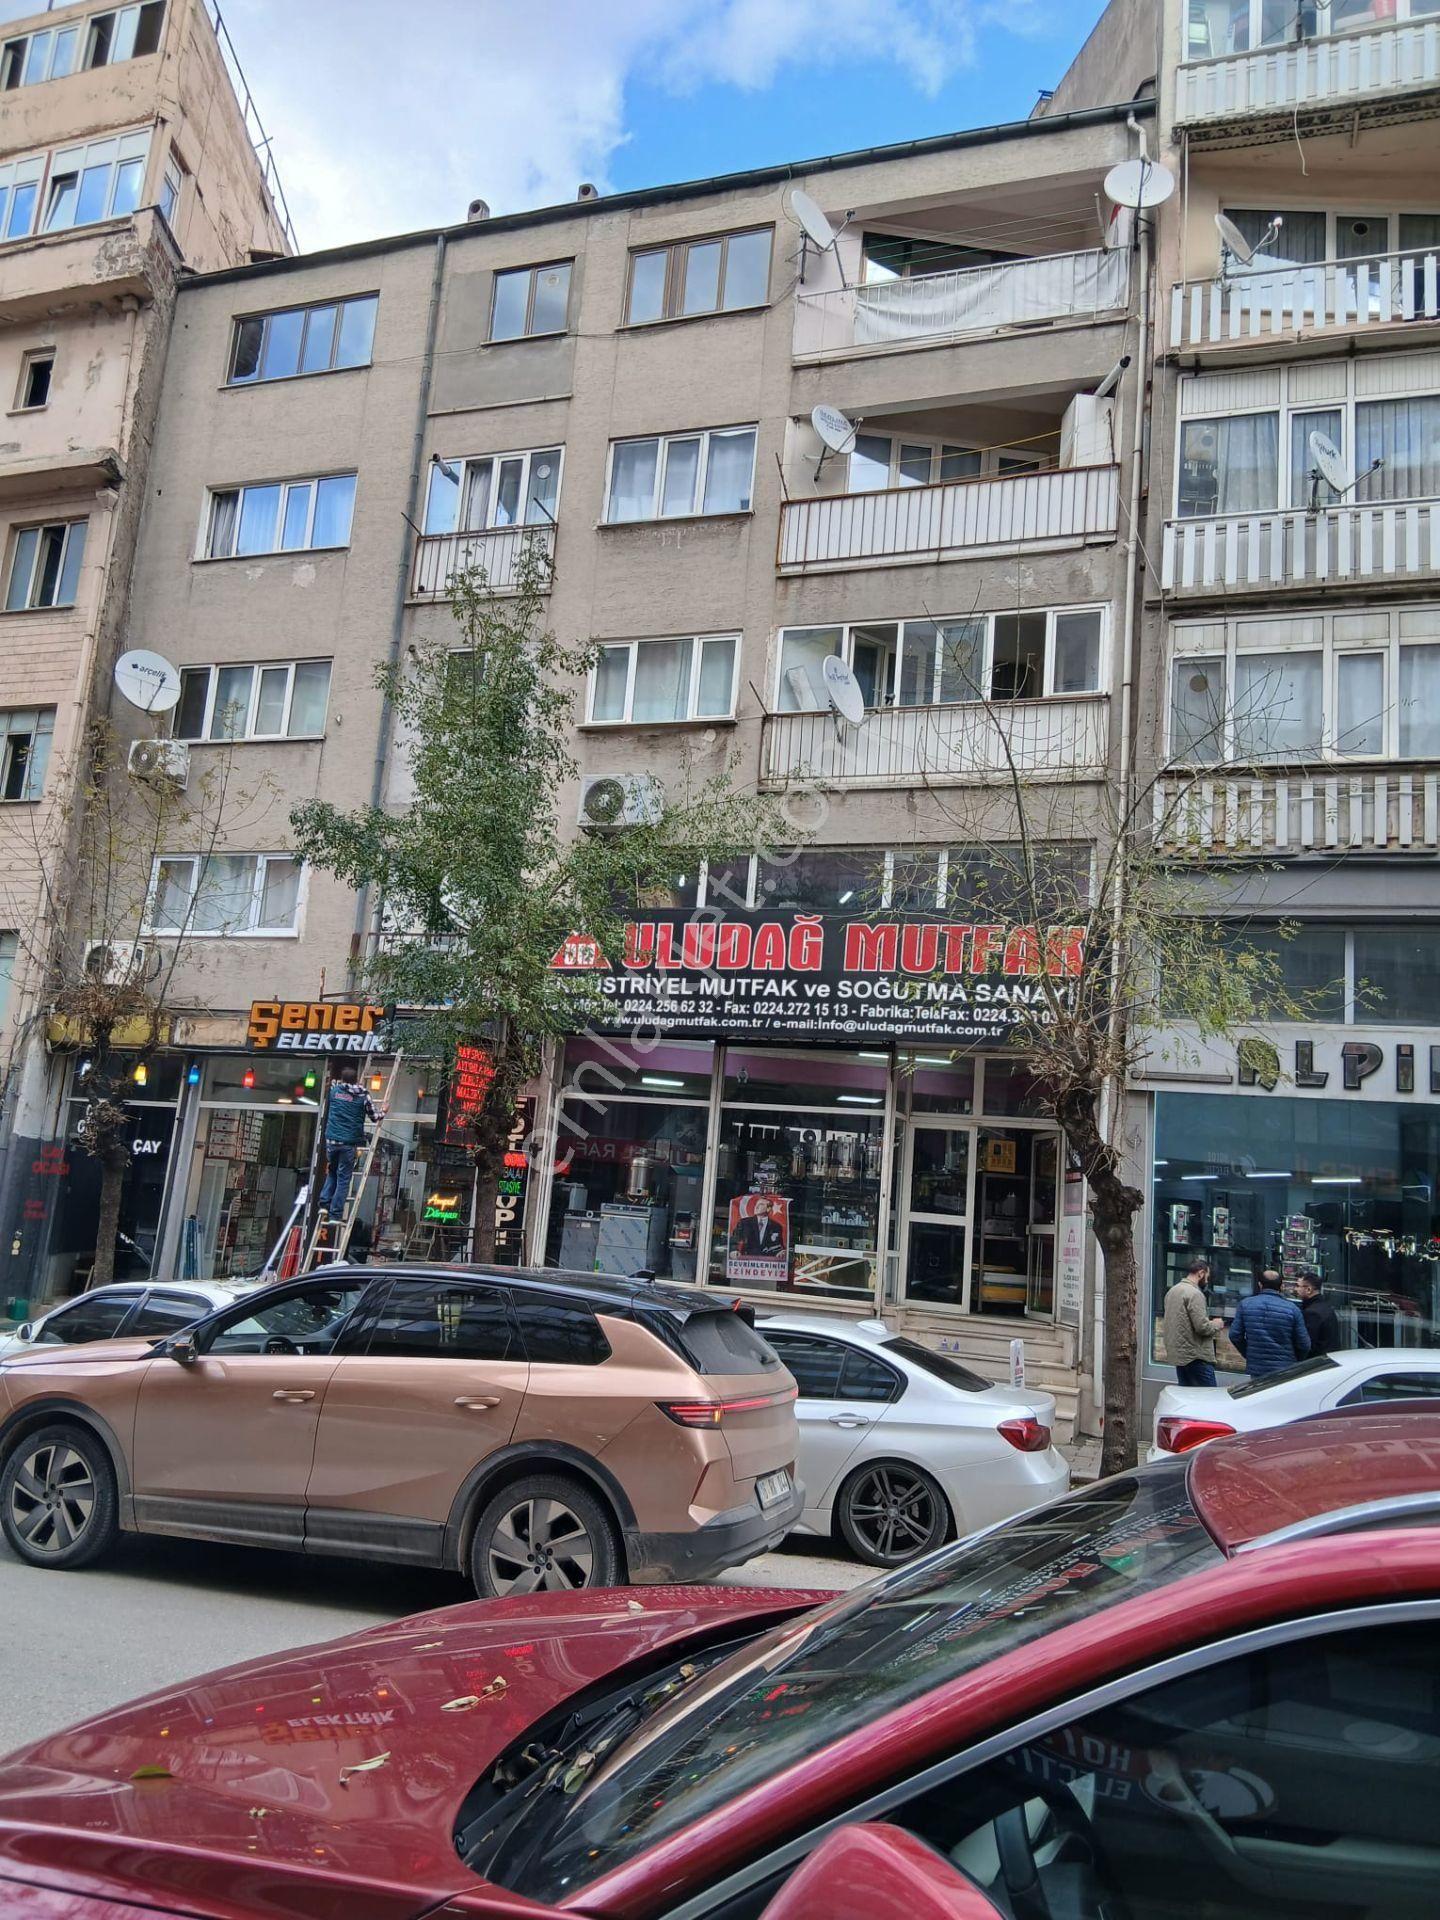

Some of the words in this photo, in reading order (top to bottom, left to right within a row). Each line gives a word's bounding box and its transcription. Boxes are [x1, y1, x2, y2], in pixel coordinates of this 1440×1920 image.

[622, 914, 824, 971] ULUDAĞ
[844, 923, 1087, 977] MUTFAK
[700, 978, 798, 997] MUTFAK
[804, 982, 831, 998] ve
[837, 977, 967, 1001] SOĞUTMA
[624, 999, 678, 1013] 0224.256
[680, 1001, 696, 1013] 62
[698, 1001, 713, 1014] 32
[724, 1001, 750, 1014] Fax:
[753, 1002, 810, 1016] 0224.272
[814, 1004, 831, 1017] 15
[833, 1004, 848, 1018] 13
[247, 1002, 385, 1048] Şener
[277, 1030, 385, 1052] ELEKTRİK
[132, 1139, 162, 1155] ÇAY
